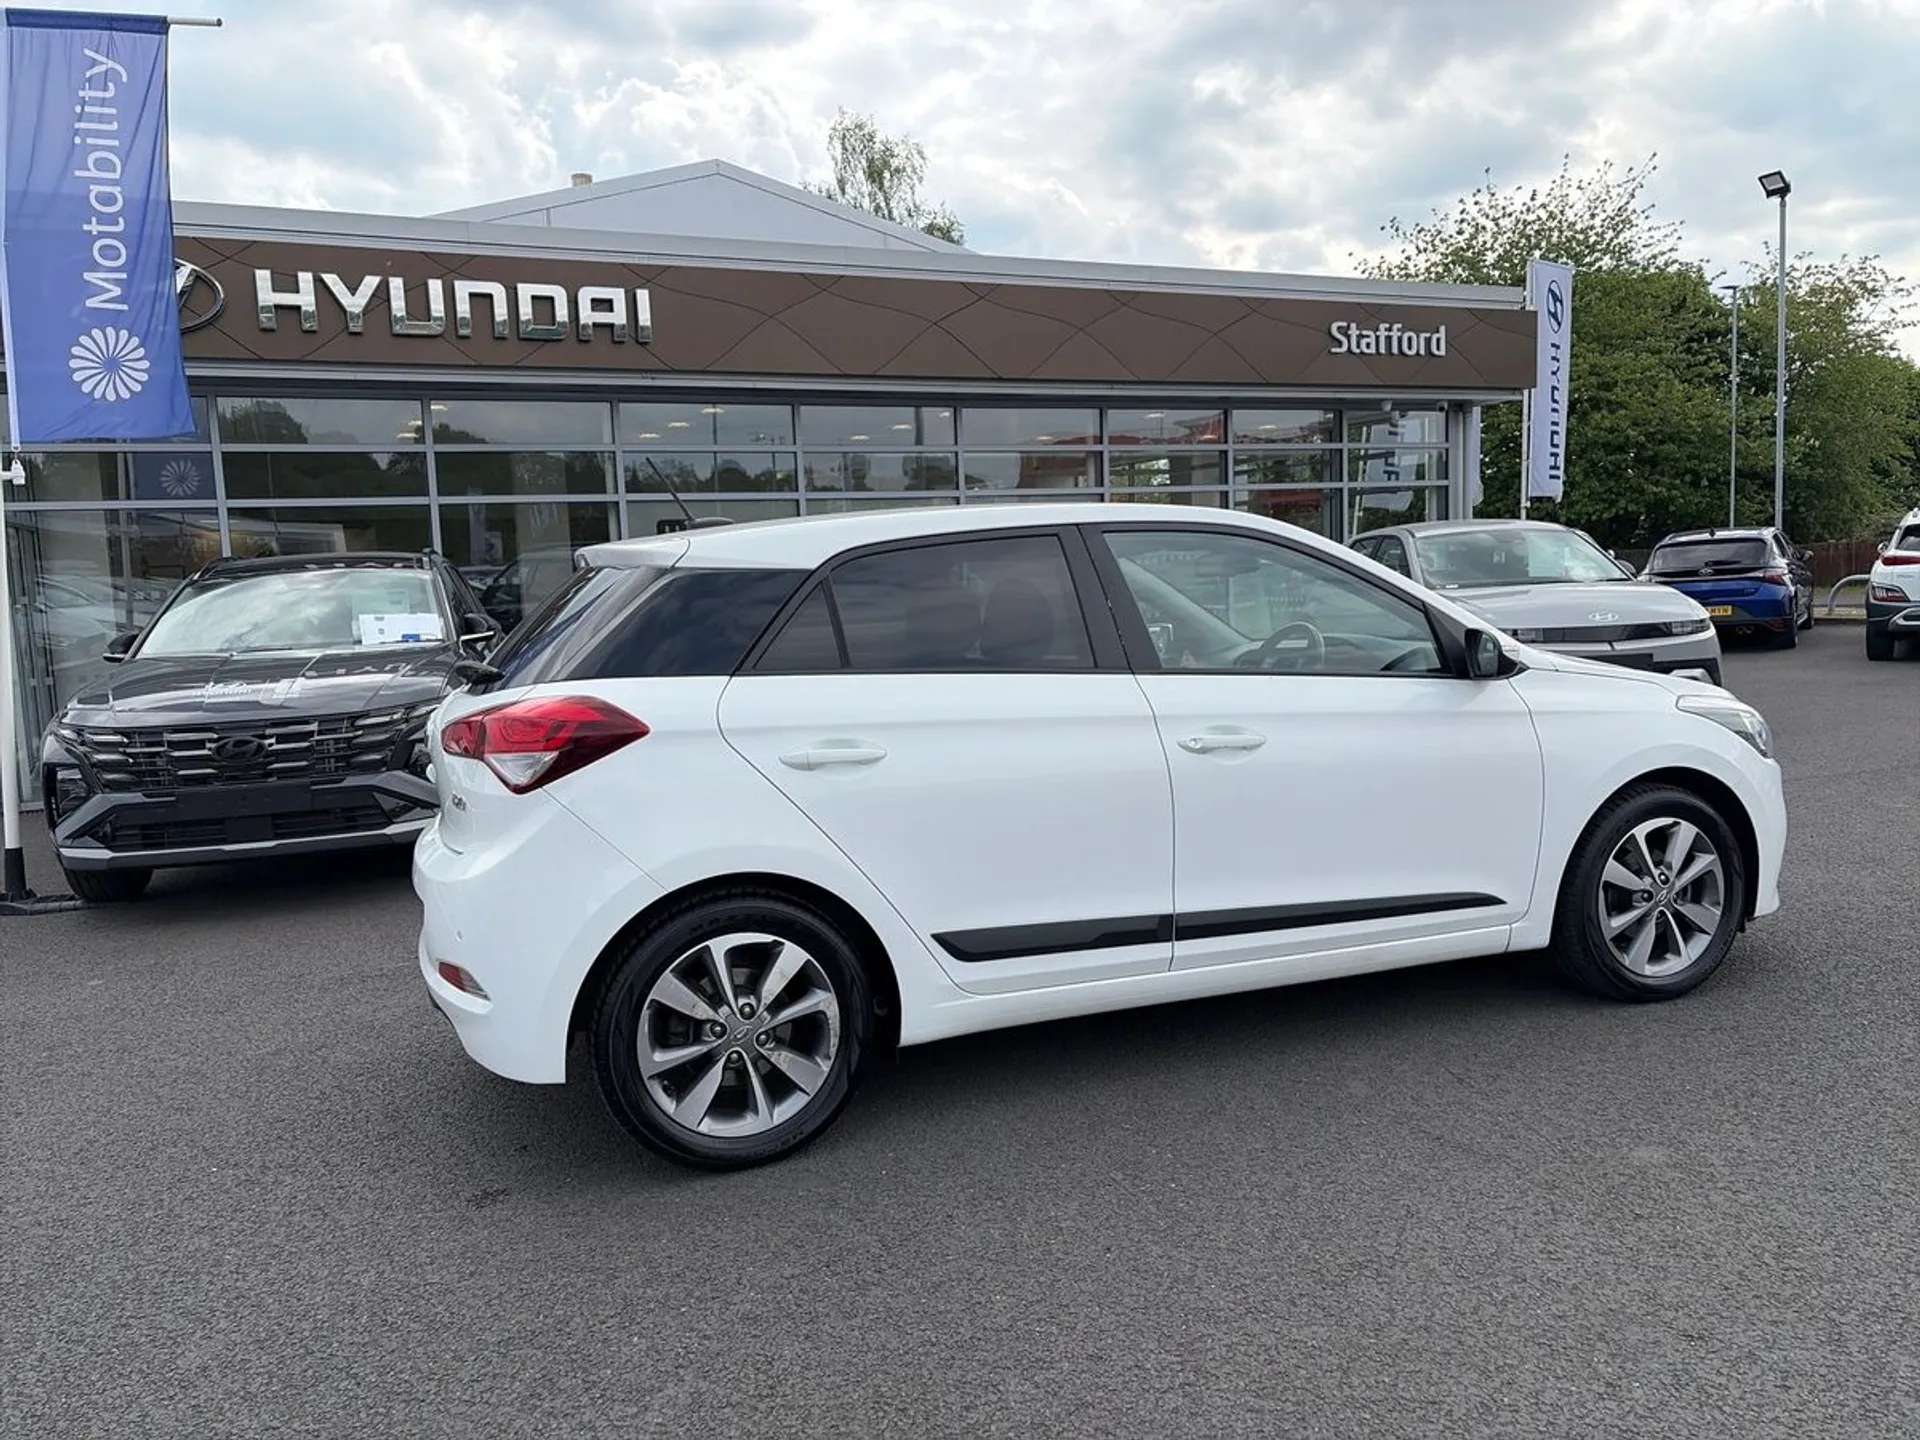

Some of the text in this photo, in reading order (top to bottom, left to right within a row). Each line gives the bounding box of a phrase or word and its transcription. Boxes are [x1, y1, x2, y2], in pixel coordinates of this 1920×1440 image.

[73, 47, 129, 311] Motability
[253, 268, 653, 344] HYUNDAI
[1329, 320, 1447, 356] Stafford
